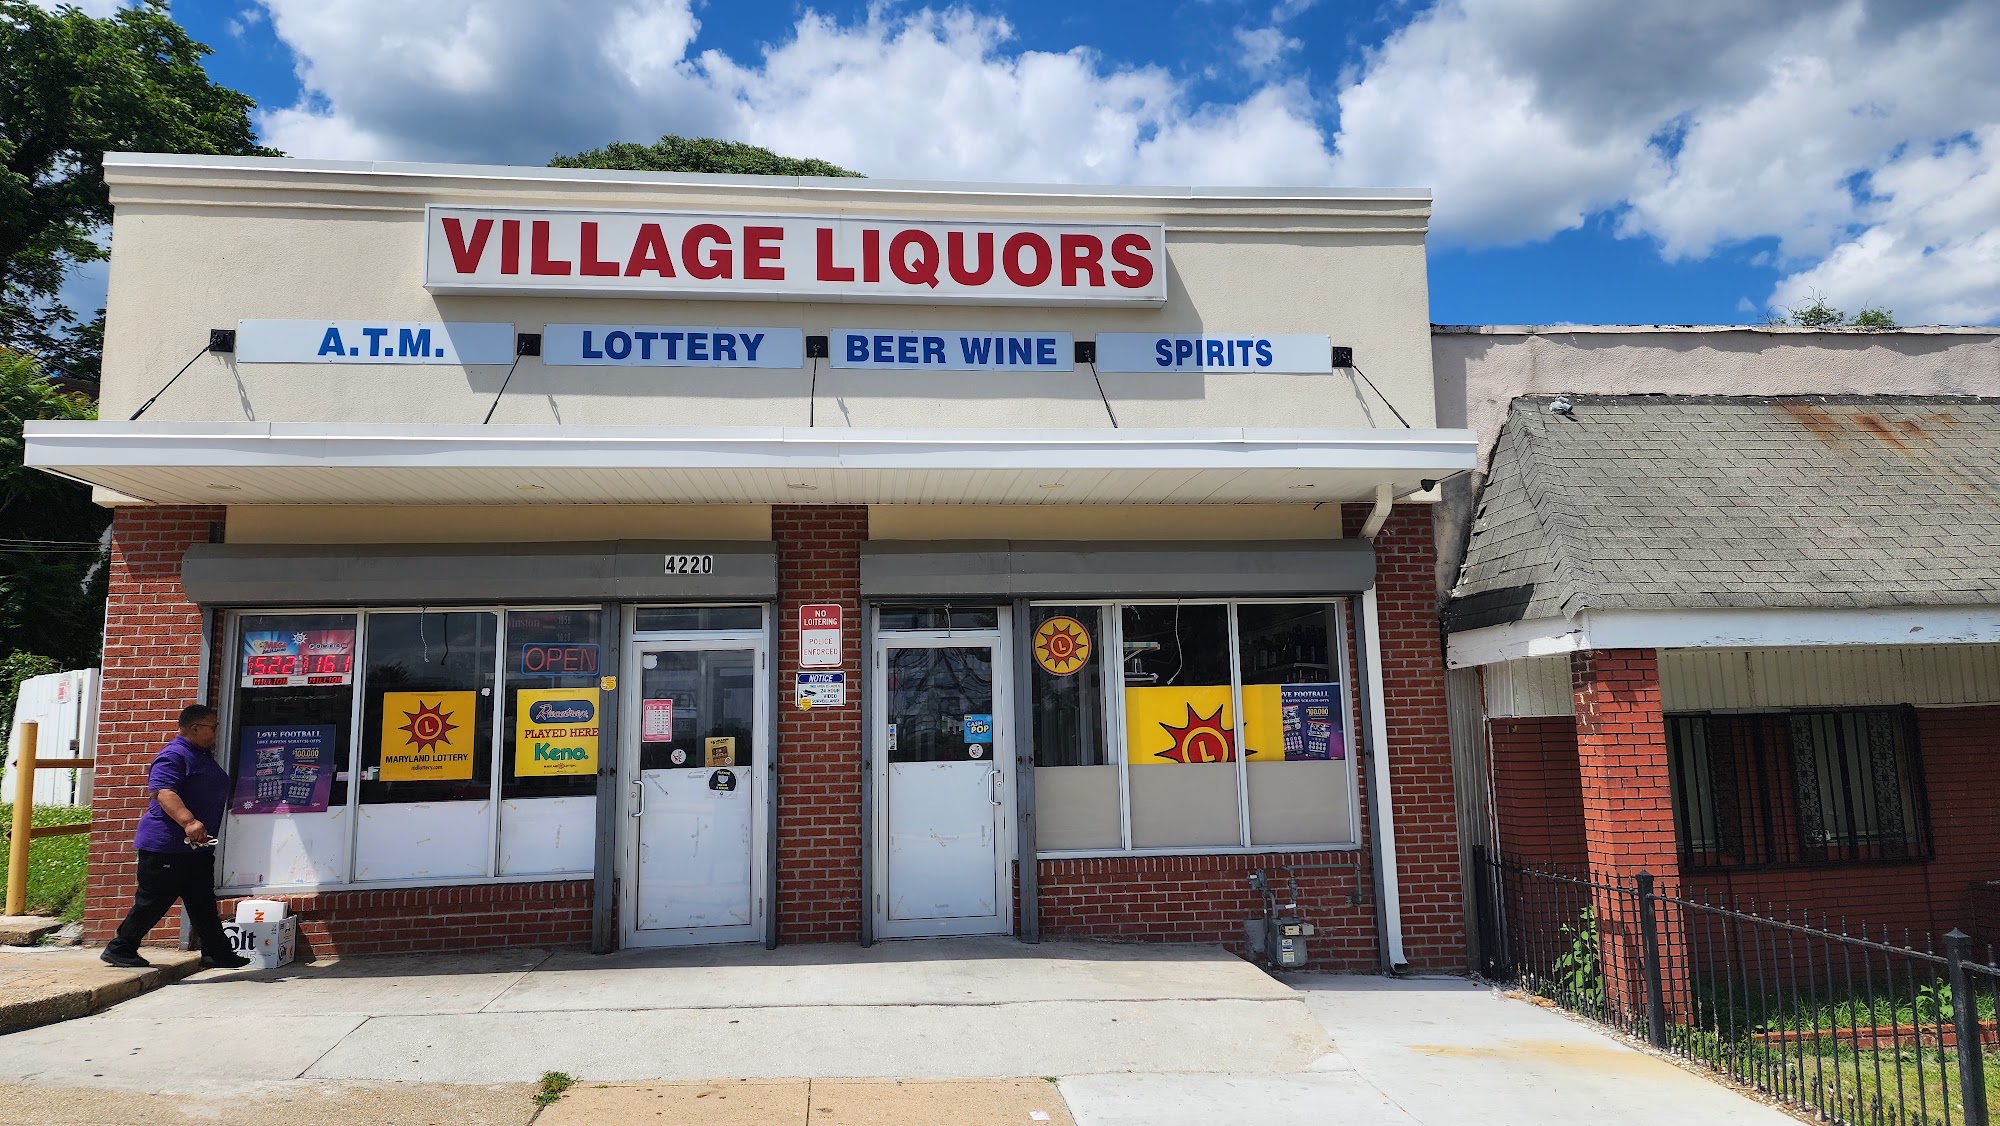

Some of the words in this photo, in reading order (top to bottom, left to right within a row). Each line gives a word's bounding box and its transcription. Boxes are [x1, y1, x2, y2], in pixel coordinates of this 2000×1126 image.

[442, 217, 786, 281] VILLAGE
[815, 227, 1154, 290] LIQUORS
[316, 326, 446, 359] A.T.M.
[580, 329, 765, 363] LOTTERY
[845, 333, 947, 367] BEER
[959, 335, 1058, 368] WINE
[1154, 337, 1274, 369] SPIRITS
[665, 555, 712, 574] 4220
[814, 609, 827, 617] NO
[508, 617, 540, 628] inston
[803, 617, 838, 626] LOITERING
[803, 648, 838, 656] ENFORCED
[316, 655, 352, 673] 161
[525, 647, 597, 671] OPEN
[255, 656, 297, 675] 522
[253, 677, 288, 686] MILLION
[308, 676, 343, 684] MILLION
[808, 674, 834, 683] NOTICE
[966, 720, 983, 728] CASH
[970, 725, 990, 734] POP
[256, 731, 278, 739] LOVE
[279, 730, 322, 738] FOOTBALL
[524, 728, 567, 739] PLAYED
[569, 727, 599, 738] HERE
[385, 754, 430, 764] MARYLAND
[432, 753, 468, 762] LOTTERY
